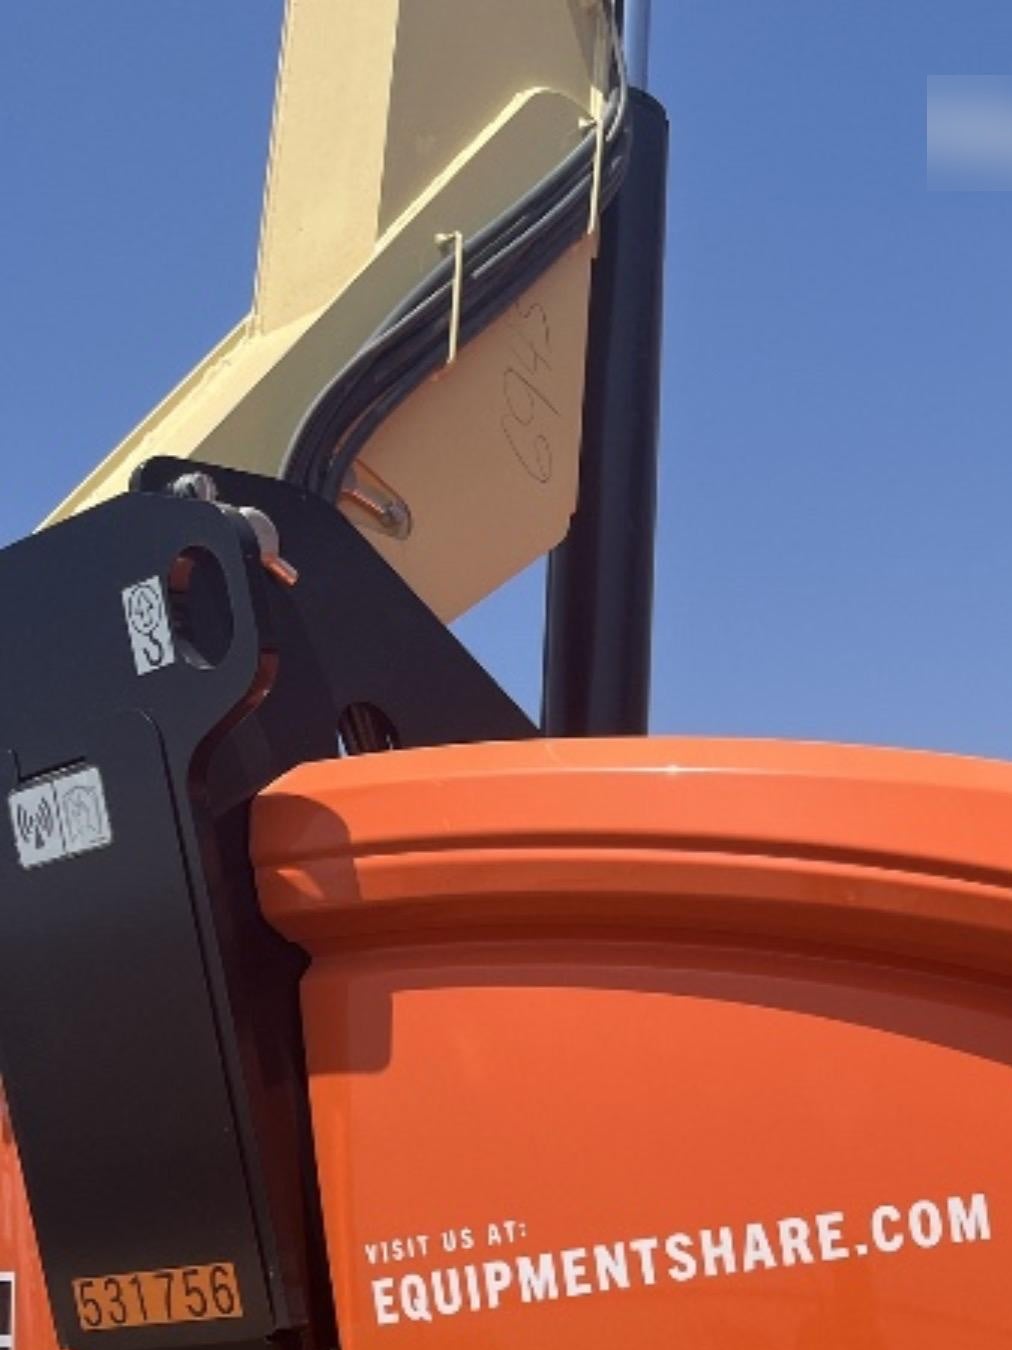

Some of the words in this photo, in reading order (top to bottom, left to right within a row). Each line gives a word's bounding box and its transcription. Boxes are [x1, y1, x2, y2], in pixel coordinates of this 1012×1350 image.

[365, 1234, 430, 1264] VISIT
[441, 1226, 475, 1252] US
[487, 1219, 527, 1246] AT:
[371, 1192, 992, 1325] EQUIPMENTSHARE.COM
[79, 1265, 236, 1327] 531756
